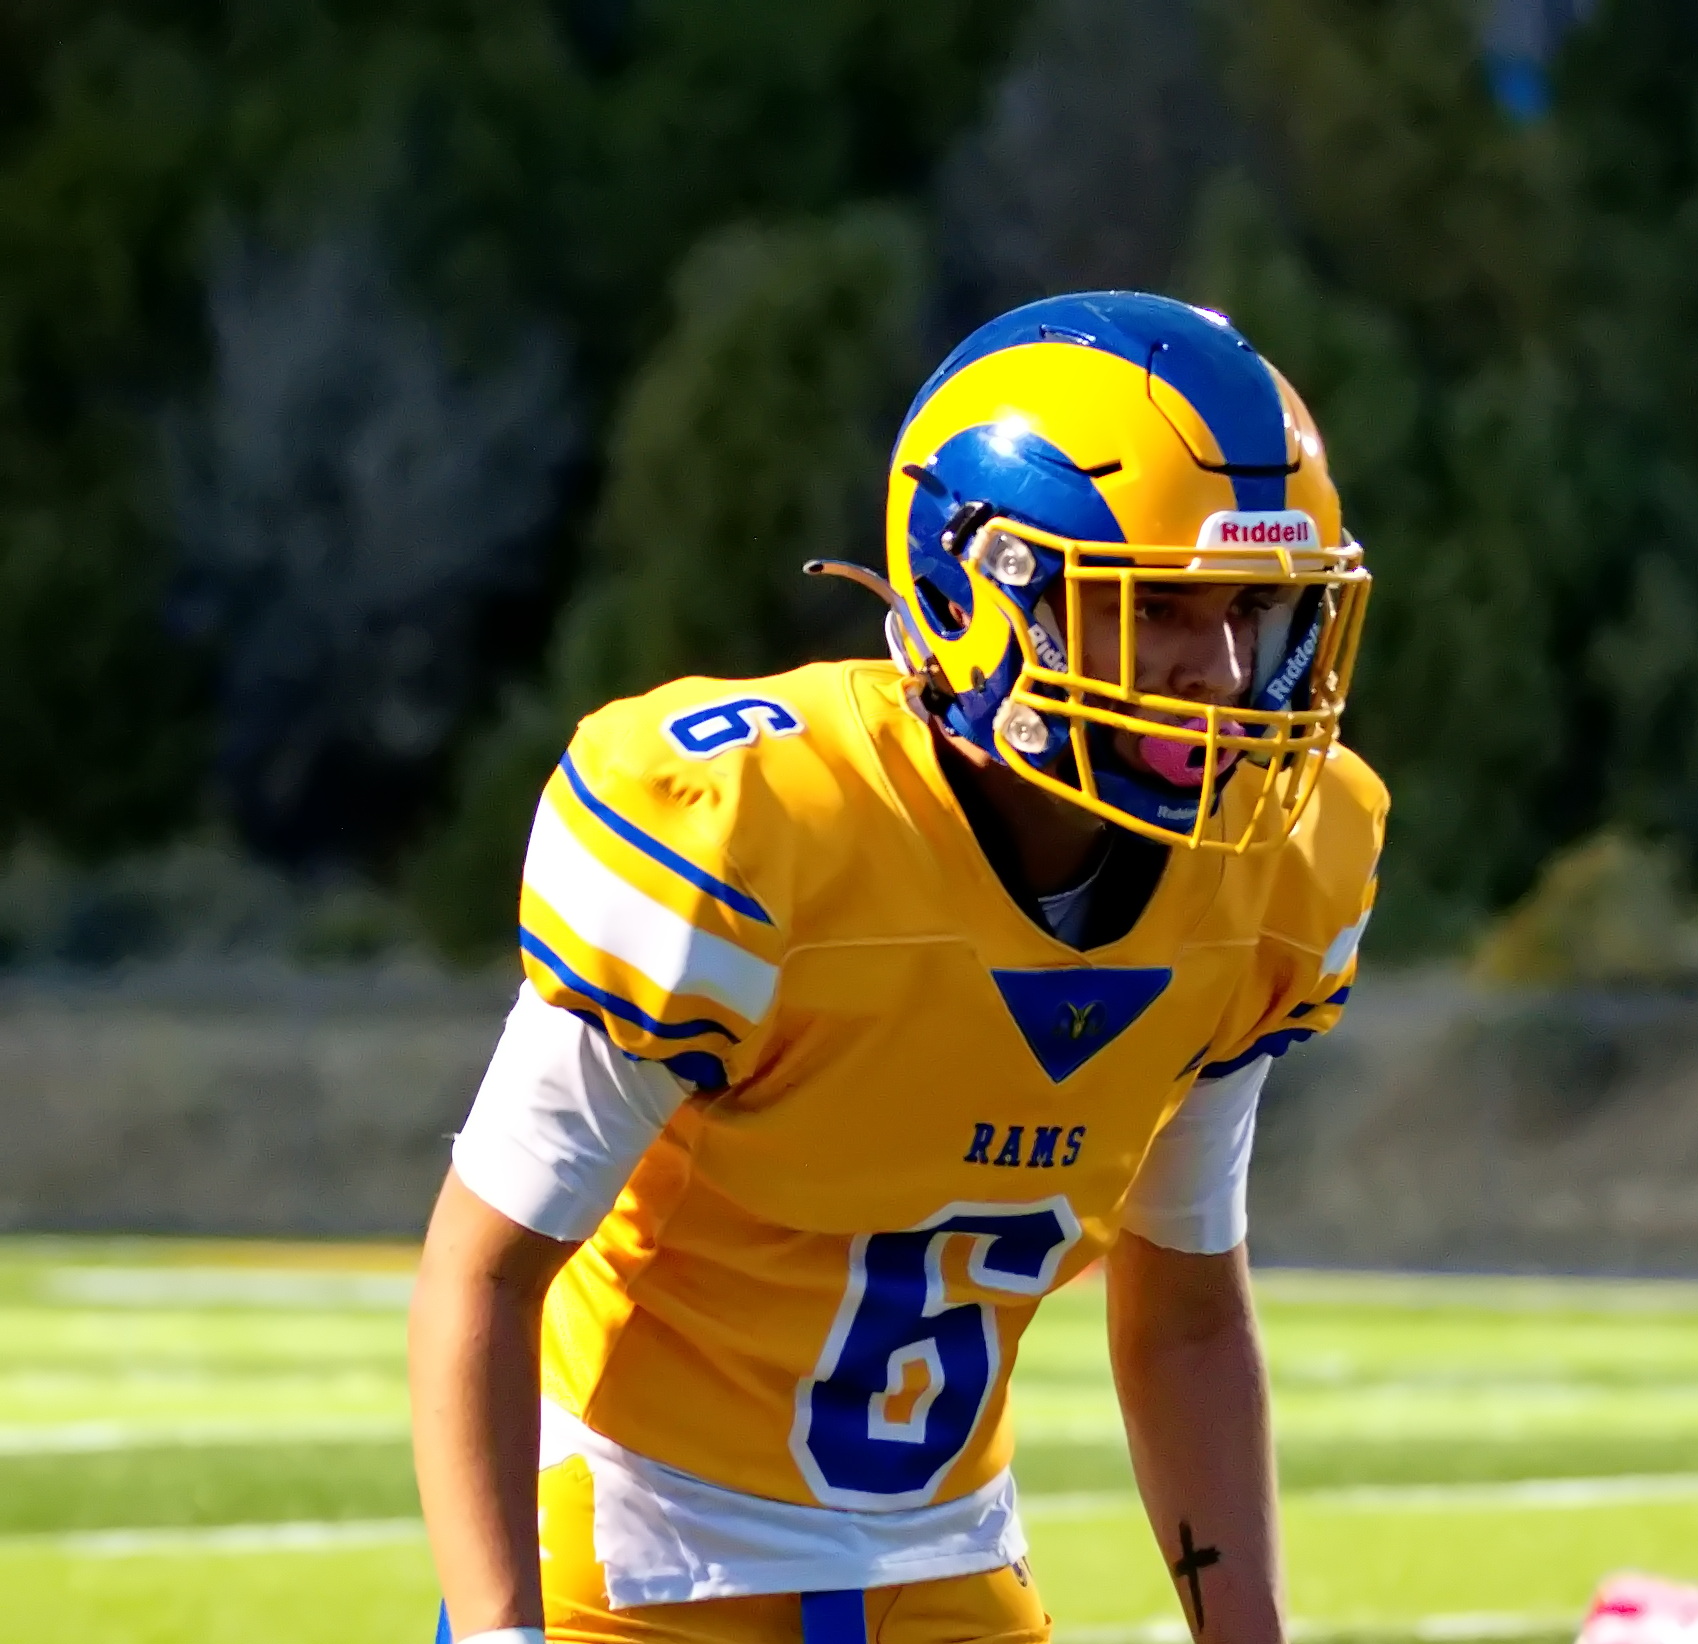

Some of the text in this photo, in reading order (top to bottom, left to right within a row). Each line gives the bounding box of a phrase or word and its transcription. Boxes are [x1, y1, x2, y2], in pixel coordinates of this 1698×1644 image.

[1220, 521, 1309, 543] Riddell
[660, 693, 805, 761] 6
[963, 1122, 1088, 1168] RAMS
[788, 1193, 1083, 1512] 6
